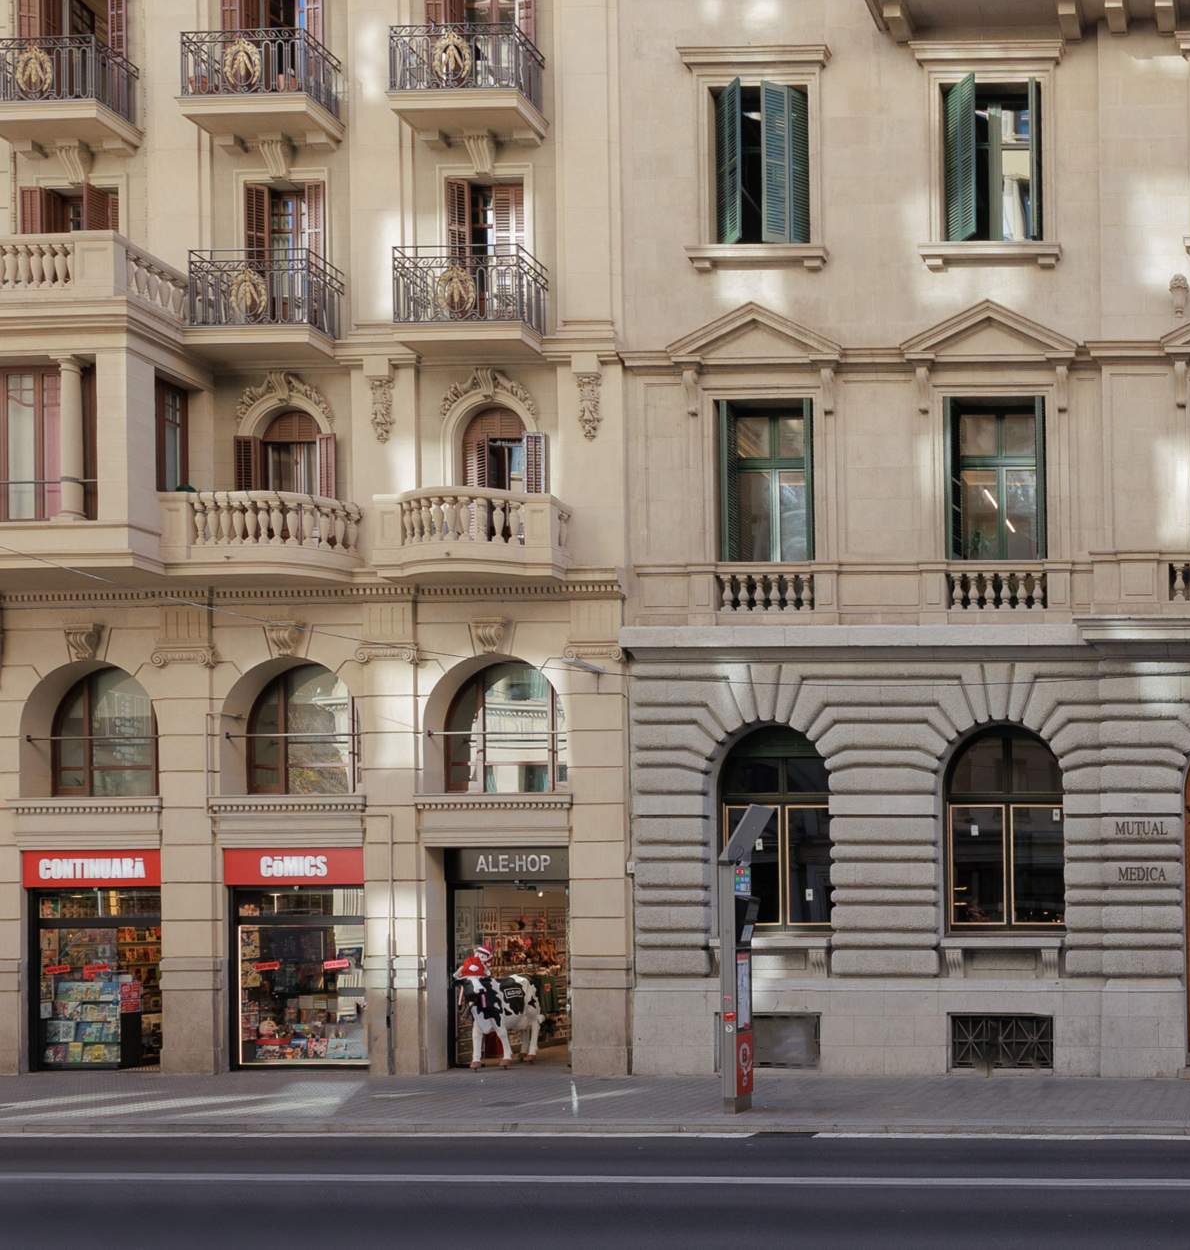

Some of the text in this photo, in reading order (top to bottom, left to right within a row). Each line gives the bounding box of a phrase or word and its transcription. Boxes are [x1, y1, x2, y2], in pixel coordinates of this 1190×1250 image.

[1115, 821, 1169, 836] MUTUAL
[475, 854, 552, 873] ALE-HOP
[1118, 866, 1167, 882] MEDICA
